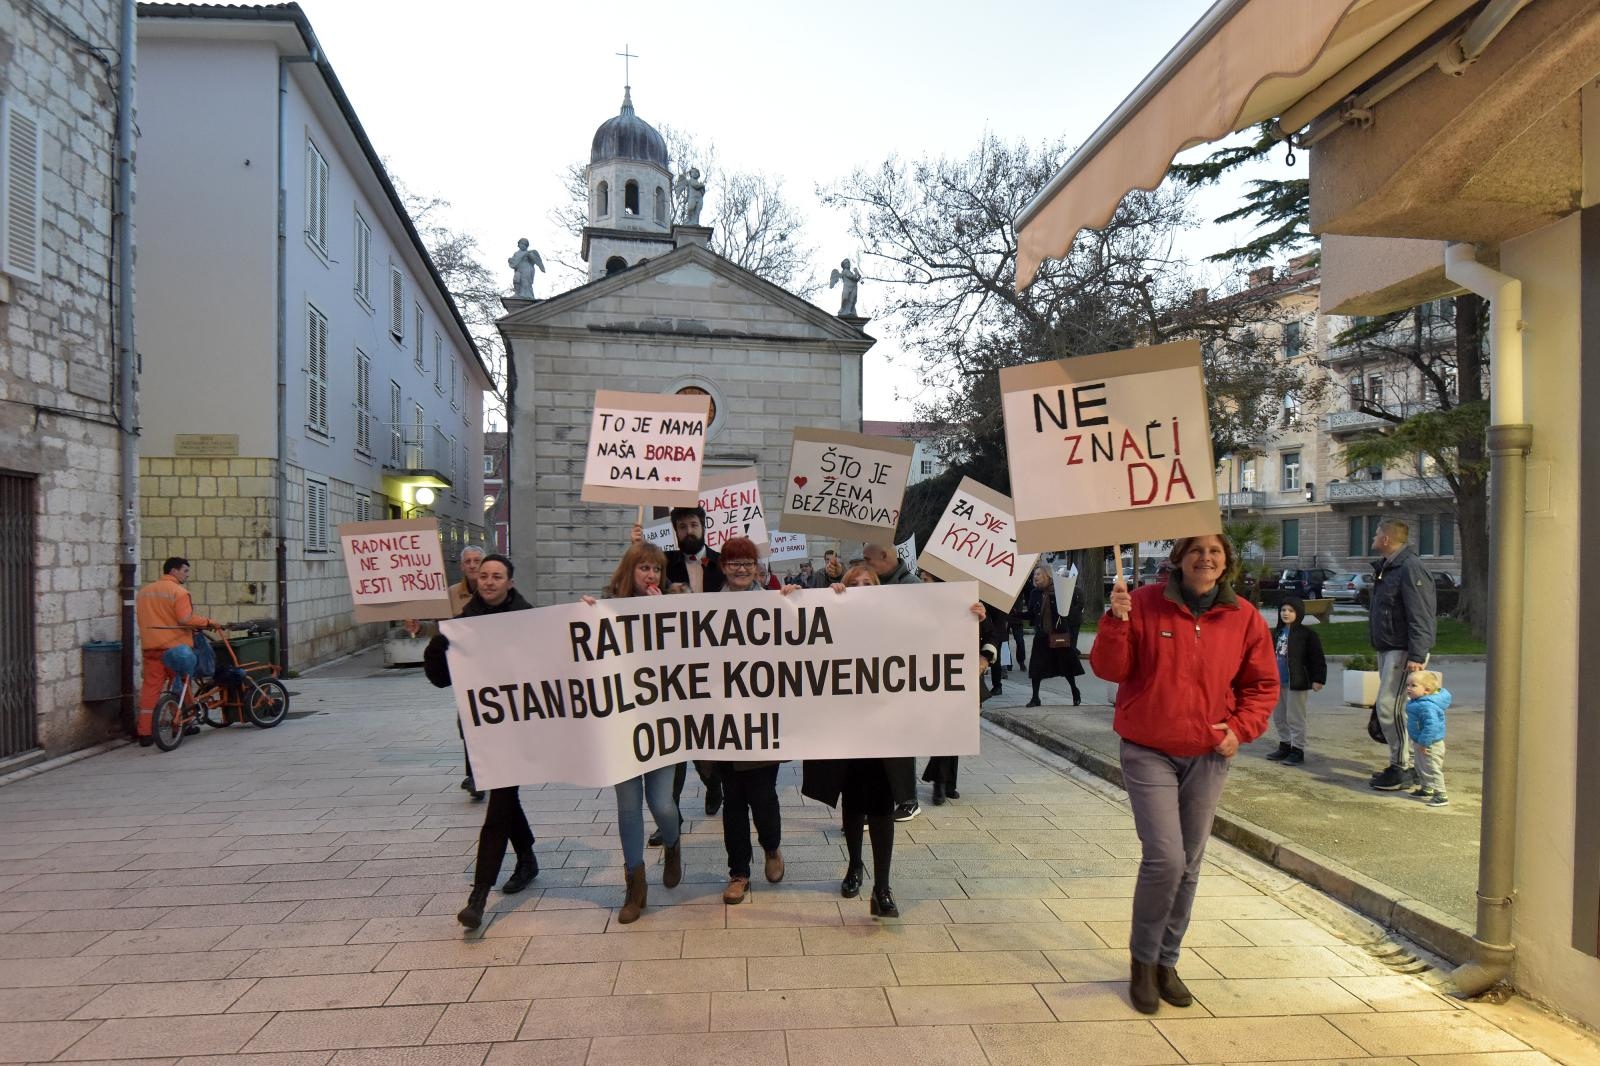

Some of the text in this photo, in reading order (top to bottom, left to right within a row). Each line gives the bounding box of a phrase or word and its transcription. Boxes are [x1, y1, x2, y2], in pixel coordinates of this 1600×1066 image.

[600, 413, 703, 436] TO JE NAMA
[1033, 383, 1109, 433] NE
[597, 439, 696, 462] NAŠA BORBA
[820, 446, 893, 485] ŠTO JE
[1128, 458, 1195, 506] DA
[722, 509, 738, 525] JE
[742, 505, 763, 522] ZA
[792, 494, 900, 526] BEZ BRKOVA?
[951, 498, 1008, 534] ZA SVE
[351, 535, 421, 554] RADNICE
[360, 553, 432, 571] NE SMIJU
[941, 522, 1015, 577] KRIVA
[355, 569, 447, 595] JESTI PRŠUT!
[569, 606, 834, 663] RATIFIKACIJA
[466, 653, 966, 727] ISTANBULSKE KONVENCIJE
[632, 712, 780, 763] ODMAH!
